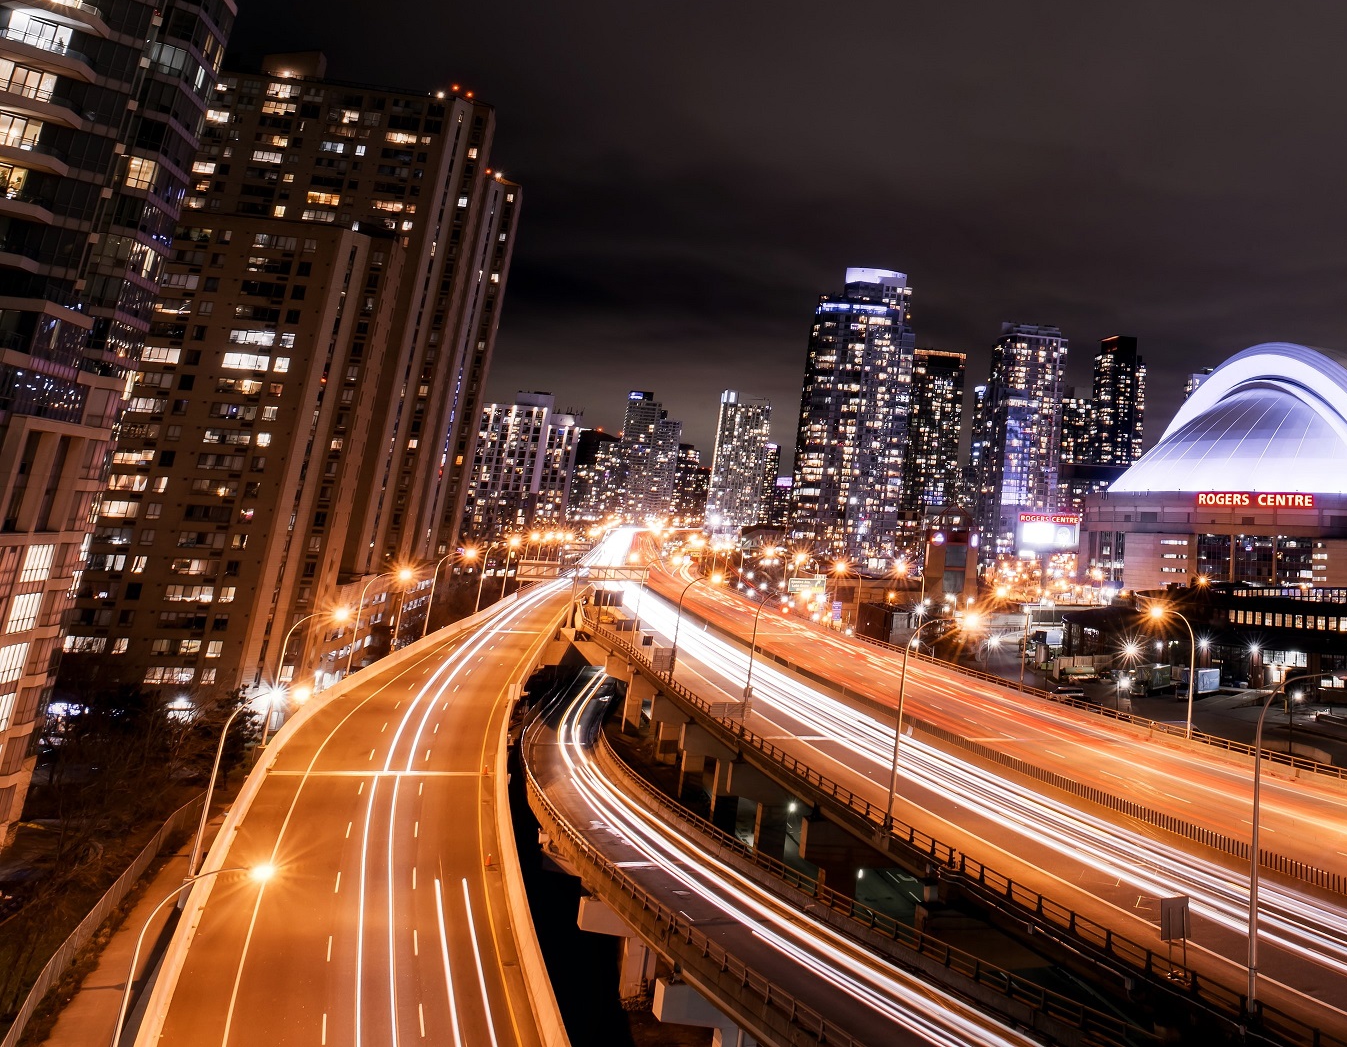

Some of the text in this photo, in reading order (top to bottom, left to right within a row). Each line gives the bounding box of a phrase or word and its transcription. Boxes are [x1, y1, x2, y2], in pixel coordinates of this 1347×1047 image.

[1198, 493, 1313, 506] ROGERS CENTRE
[1020, 515, 1079, 524] ROGERS CENTRE
